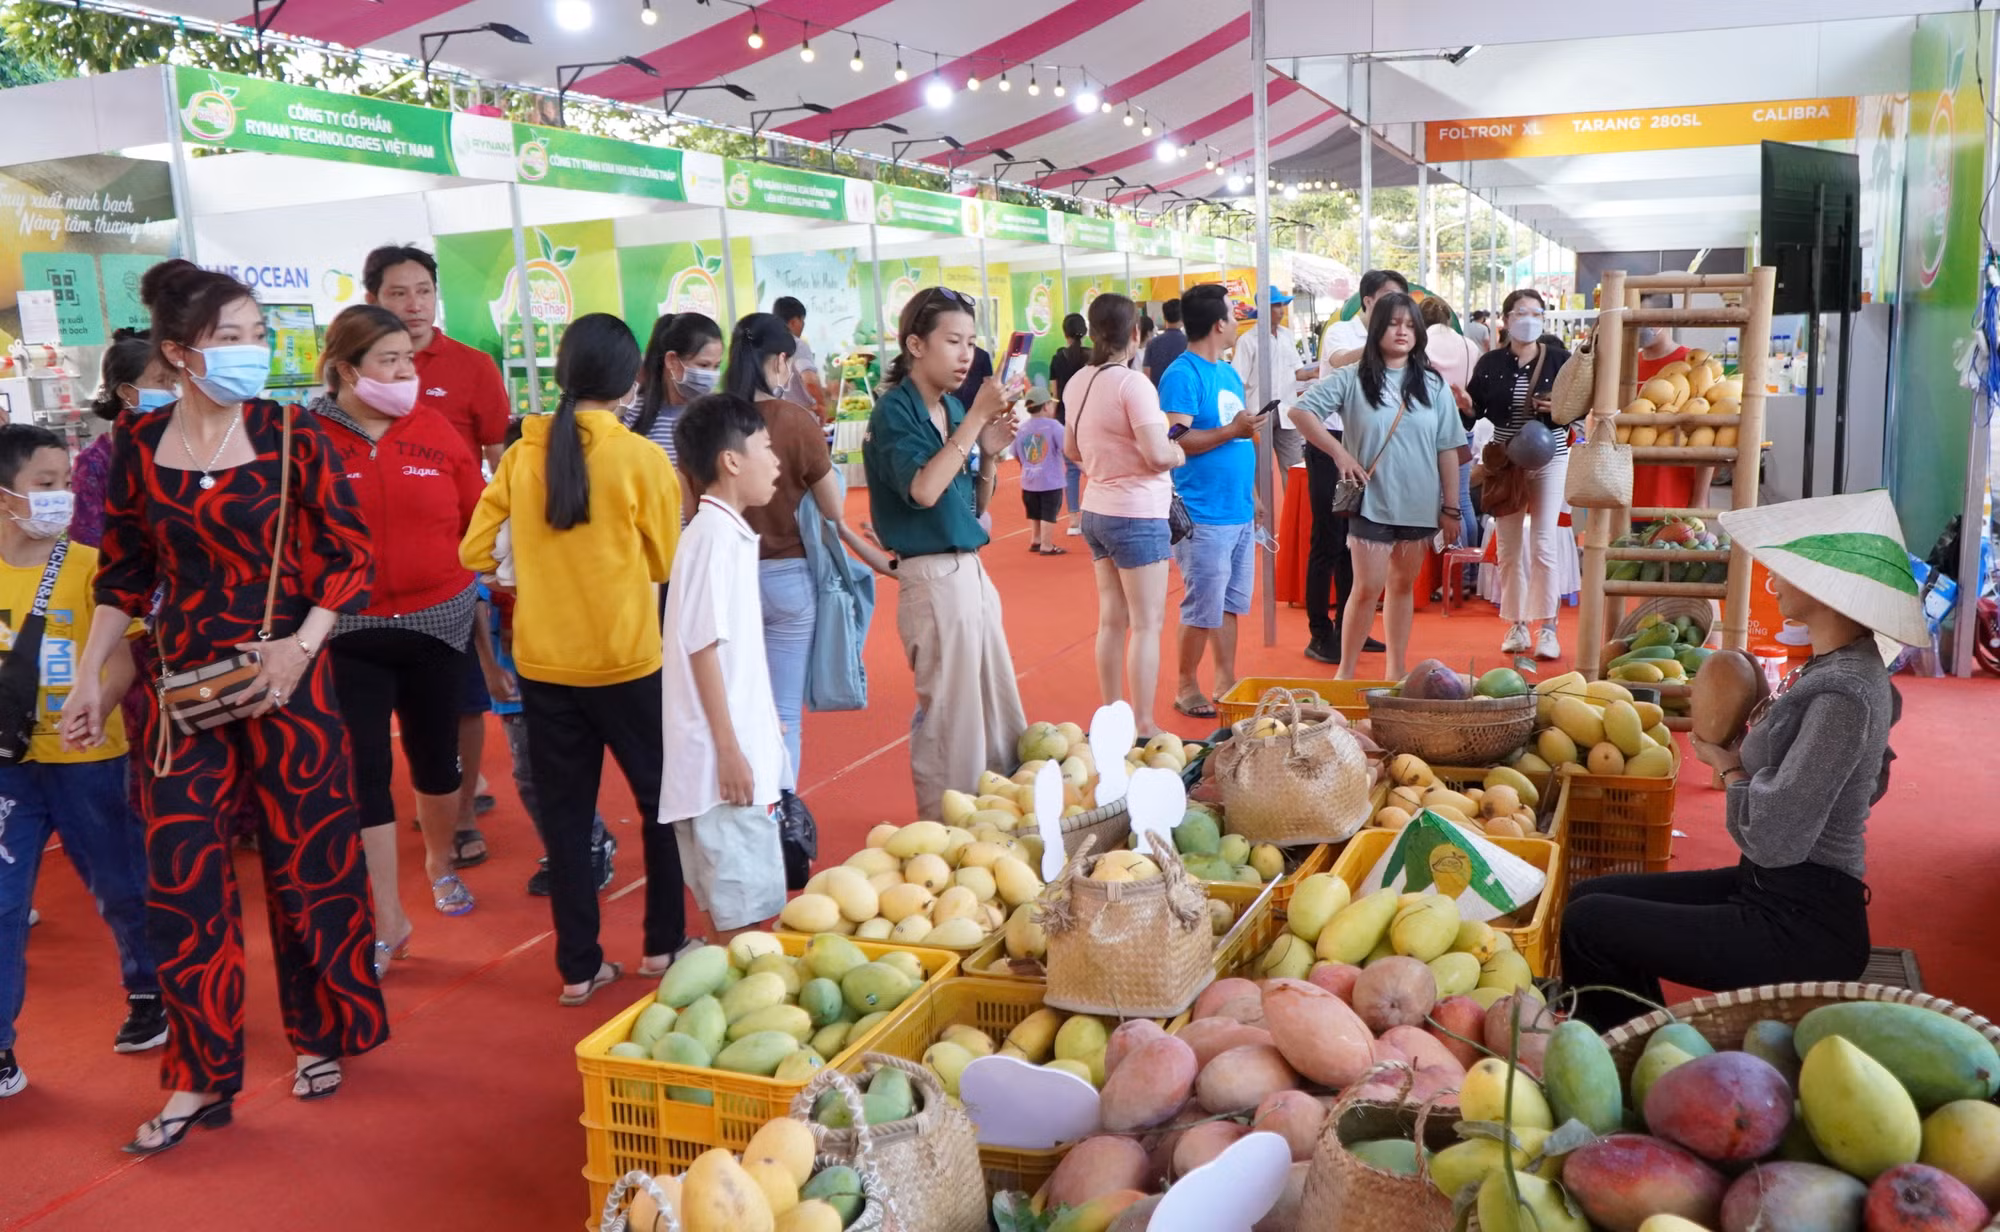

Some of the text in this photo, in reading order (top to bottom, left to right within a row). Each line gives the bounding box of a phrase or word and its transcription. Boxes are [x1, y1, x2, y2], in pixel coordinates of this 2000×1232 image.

[288, 102, 324, 124] CÔNG
[324, 110, 340, 126] TY
[1522, 121, 1543, 136] XL
[1650, 113, 1702, 129] 280SL
[1752, 105, 1831, 122] CALIBRA
[245, 119, 435, 158] RYNAN TECHNOLOGIES VIỆT NAM
[32, 190, 65, 209] xuất
[66, 192, 101, 212] minh
[103, 193, 134, 216] bạch
[20, 212, 61, 241] Nâng
[65, 214, 93, 233] tầm
[245, 266, 309, 289] OCEAN
